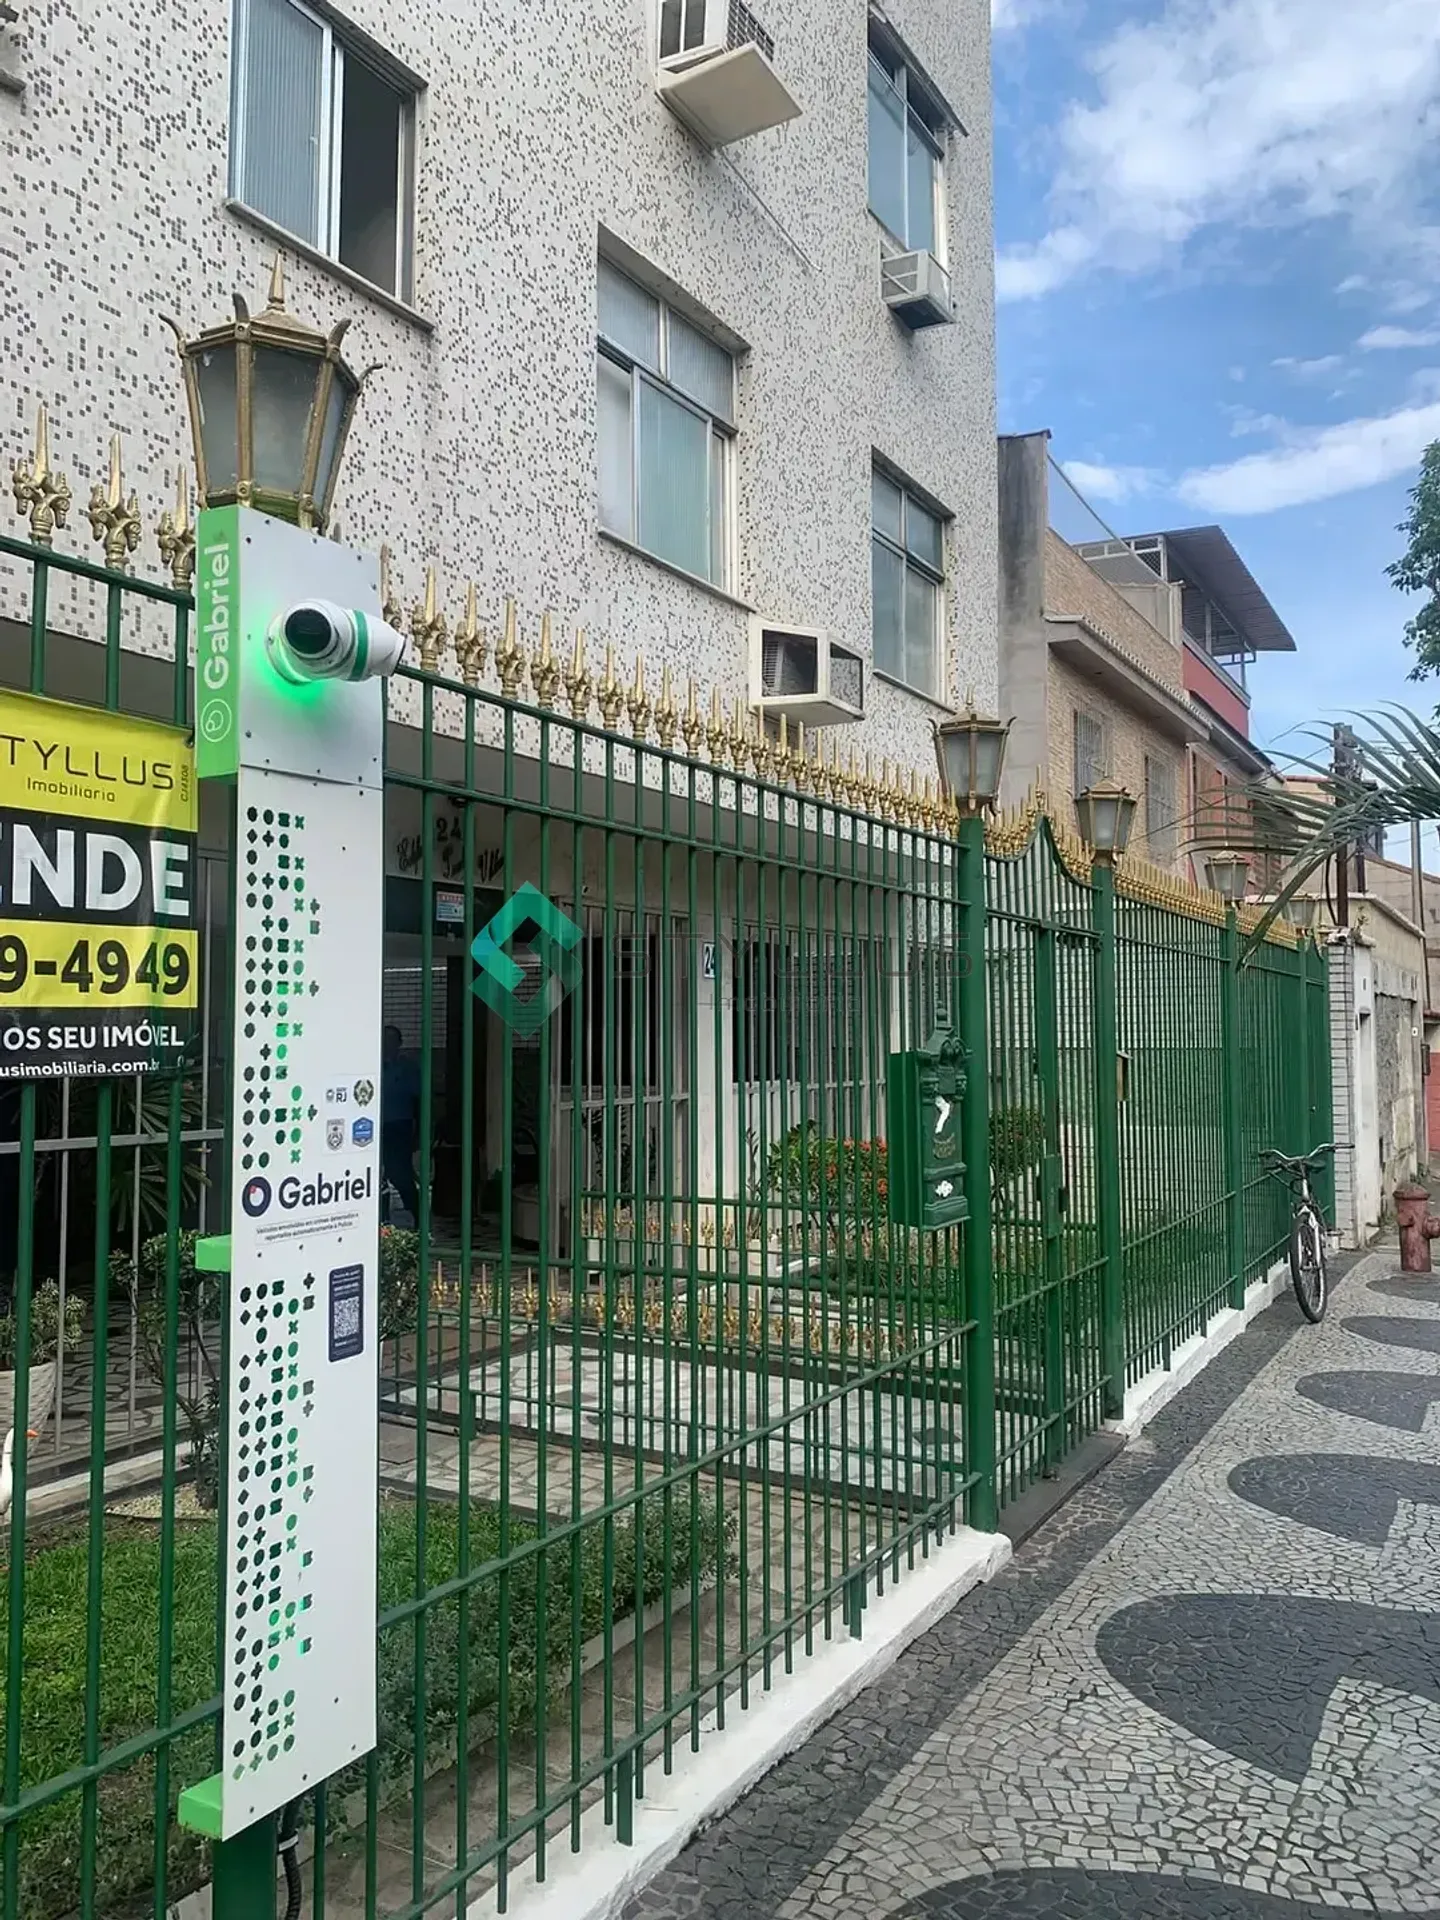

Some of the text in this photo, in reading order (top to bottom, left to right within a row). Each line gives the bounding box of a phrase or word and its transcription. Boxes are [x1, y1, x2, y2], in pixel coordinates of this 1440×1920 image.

[203, 542, 230, 690] Gabriel
[0, 734, 173, 790] TYLLUS
[27, 777, 116, 803] Imobiliaria
[0, 822, 190, 916] NDE
[3, 1018, 185, 1050] OS SEU IMÓVEL
[278, 1166, 371, 1210] Gabriel
